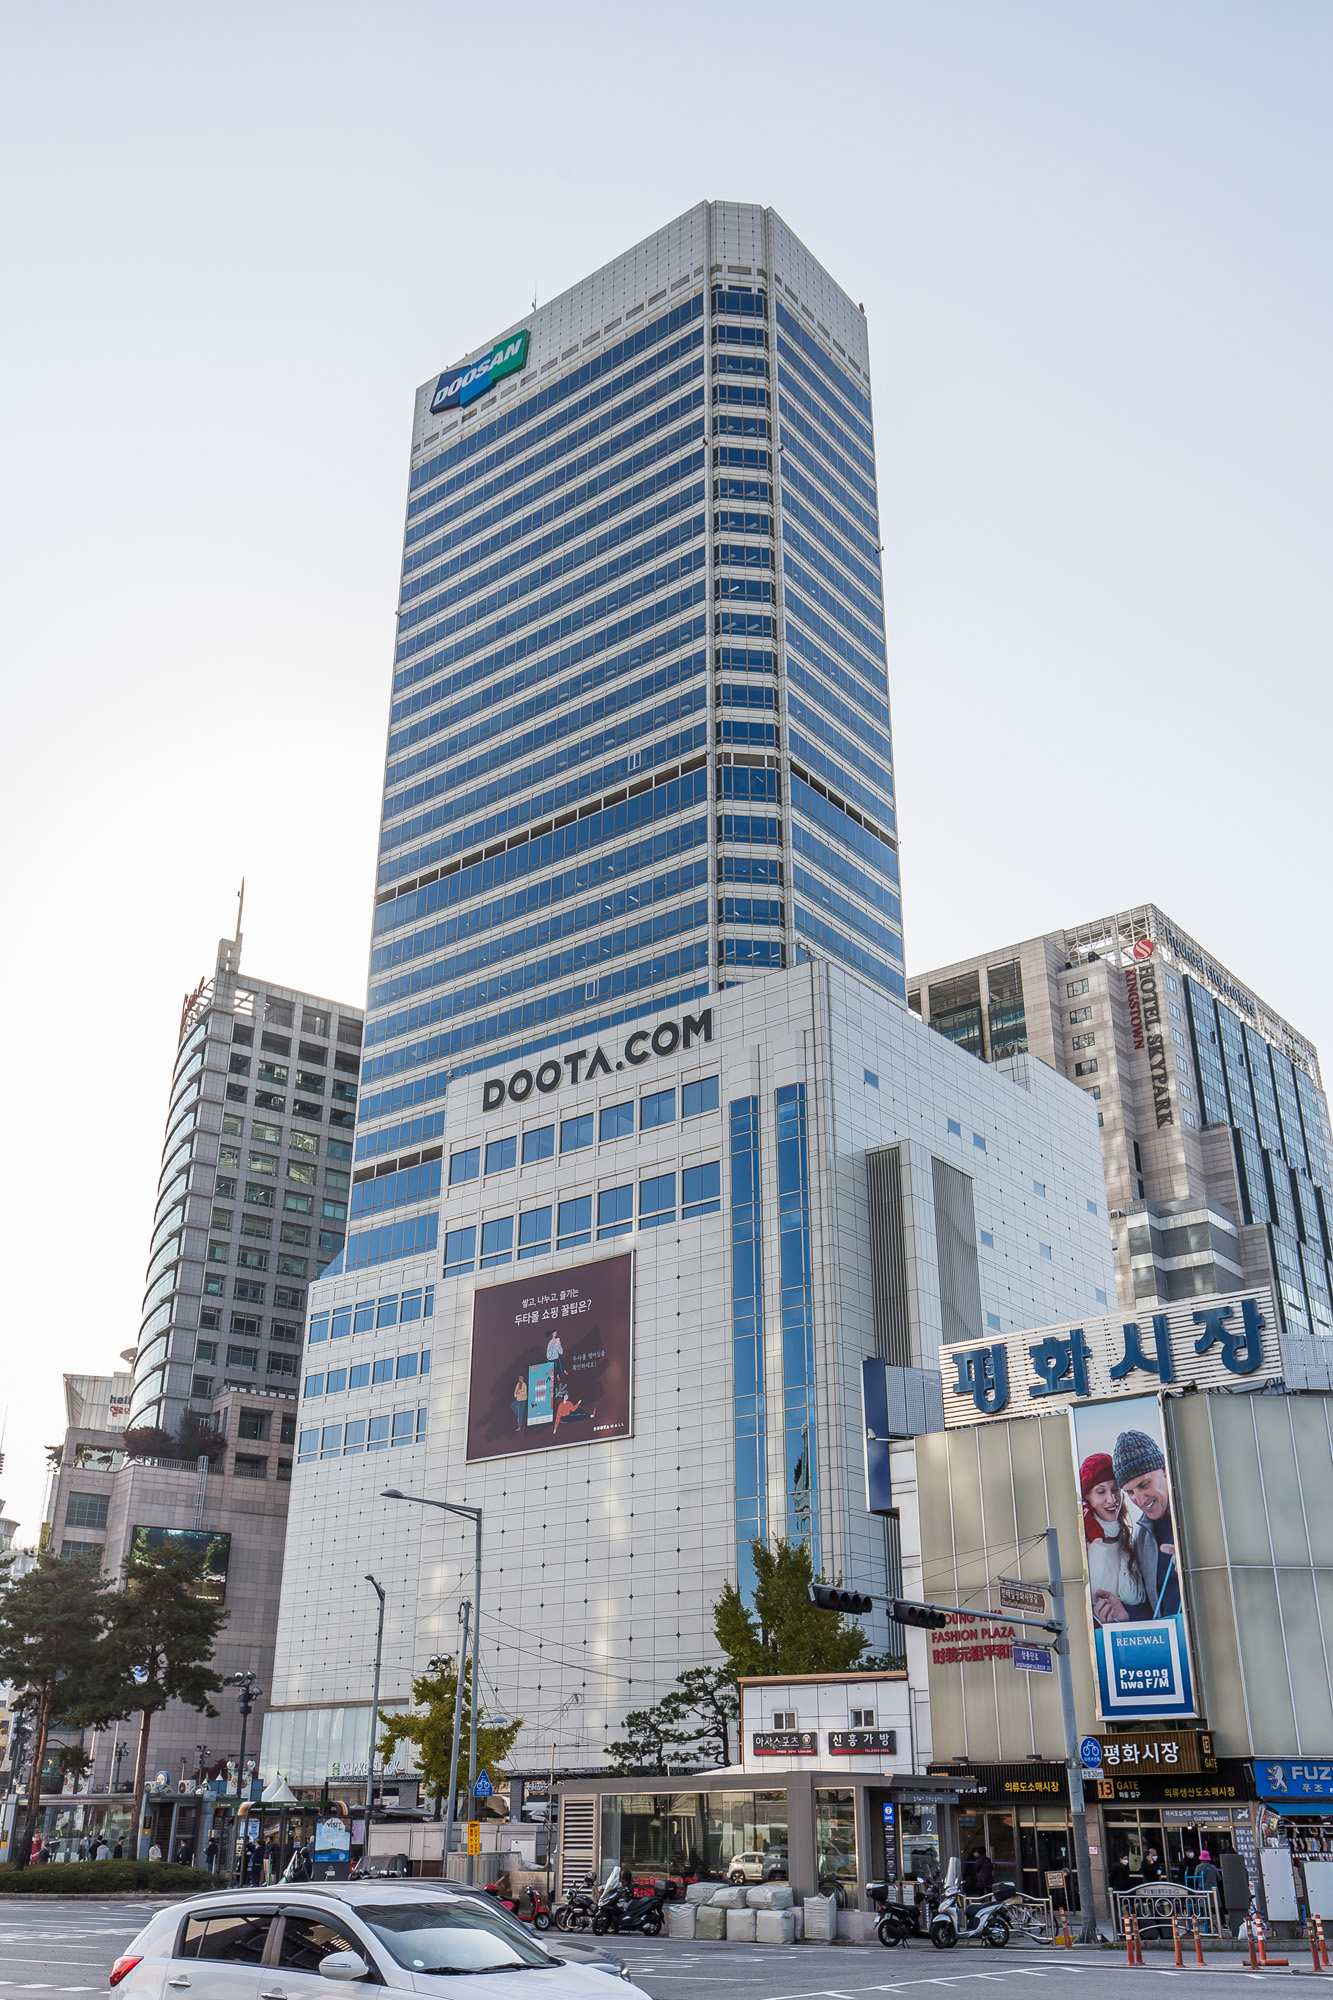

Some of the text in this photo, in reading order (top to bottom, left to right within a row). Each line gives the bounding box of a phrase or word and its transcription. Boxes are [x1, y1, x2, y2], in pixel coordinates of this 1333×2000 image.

[433, 338, 522, 407] DOOSAN
[1125, 968, 1145, 1050] KINGSTOWN
[1139, 964, 1173, 1129] HOTEL SKYPARK
[483, 1008, 713, 1112] DOOTA.COM
[537, 1293, 558, 1304] 나누고,
[559, 1288, 579, 1300] 즐기는
[514, 1299, 592, 1326] 두타몰 쇼핑 꿀팁은?
[952, 1300, 1266, 1413] 평화시장
[931, 1626, 1016, 1643] FASHION PLAZA
[1116, 1635, 1166, 1647] RENEWAL
[1119, 1668, 1169, 1680] Pyeong
[1120, 1678, 1170, 1690] hwa F/M
[1103, 1741, 1180, 1766] 평화시장
[1204, 1757, 1218, 1769] GATE
[1291, 1766, 1333, 1780] FUZ
[1005, 1781, 1060, 1793] 의류도소매시장
[1098, 1780, 1140, 1797] 13 GATE
[1164, 1786, 1236, 1798] 의류생산도소매시장
[926, 1820, 932, 1832] 2
